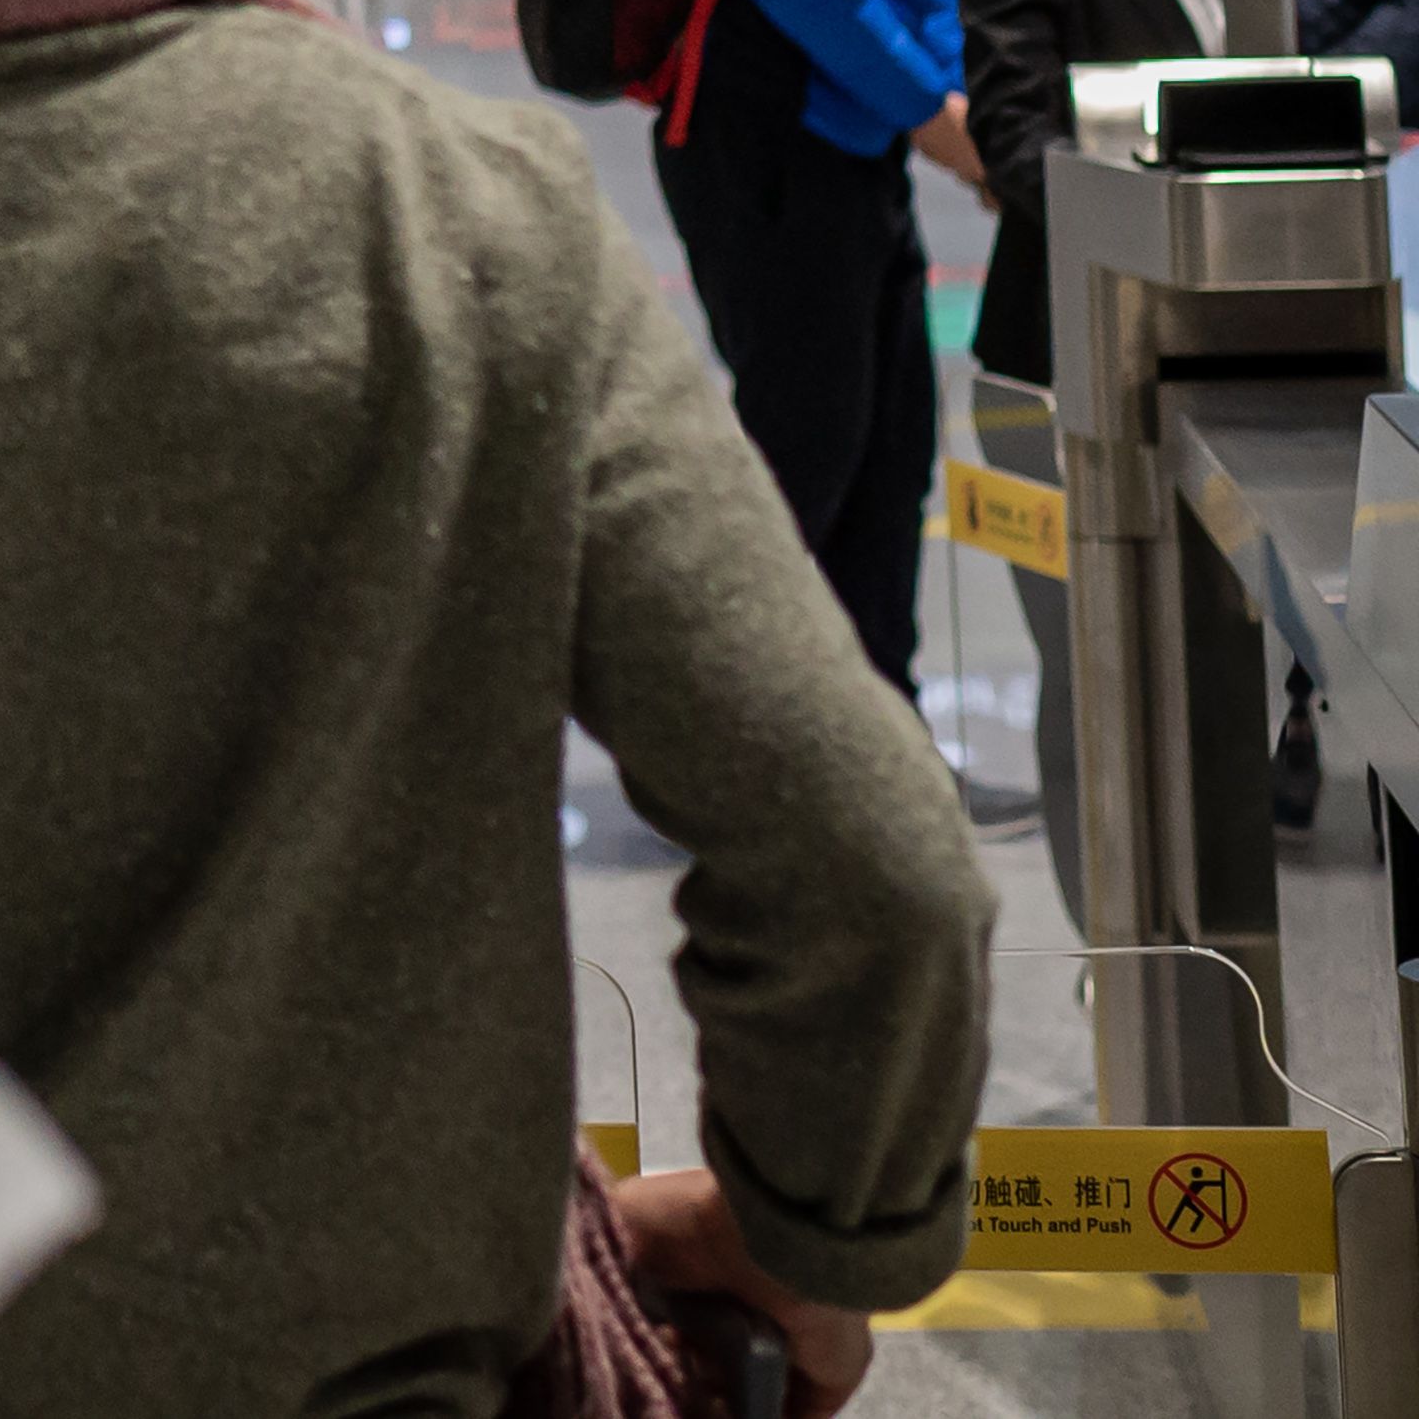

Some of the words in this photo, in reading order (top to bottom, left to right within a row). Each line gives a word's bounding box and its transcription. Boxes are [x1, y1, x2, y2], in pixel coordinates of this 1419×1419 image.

[989, 1217, 1042, 1233] Touch
[1048, 1217, 1081, 1233] and
[1087, 1217, 1132, 1233] Push
